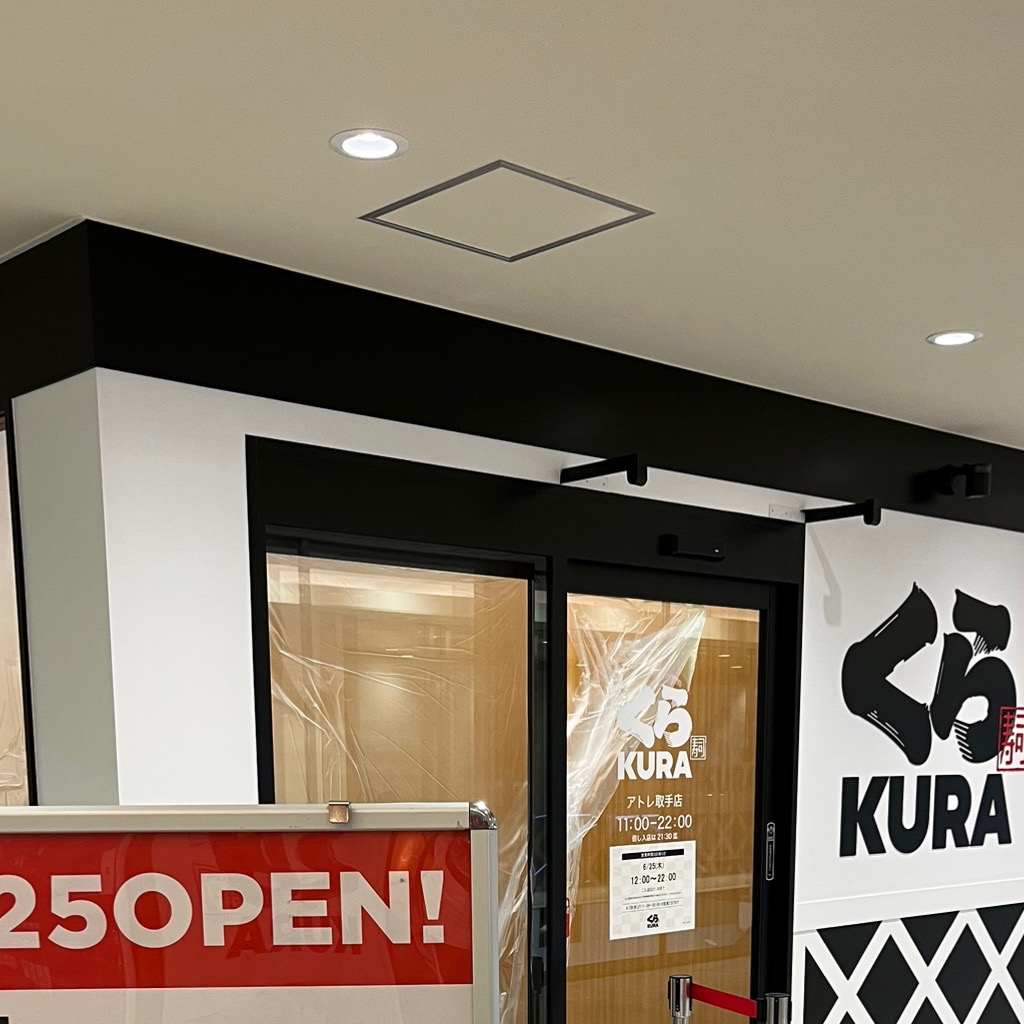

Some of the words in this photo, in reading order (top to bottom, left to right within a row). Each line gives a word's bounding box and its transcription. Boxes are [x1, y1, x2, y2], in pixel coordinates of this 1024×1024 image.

[617, 751, 694, 781] KURA
[626, 794, 684, 810] アトレ取手店
[616, 814, 694, 833] 11:00-22:00
[839, 774, 1012, 858] KURA
